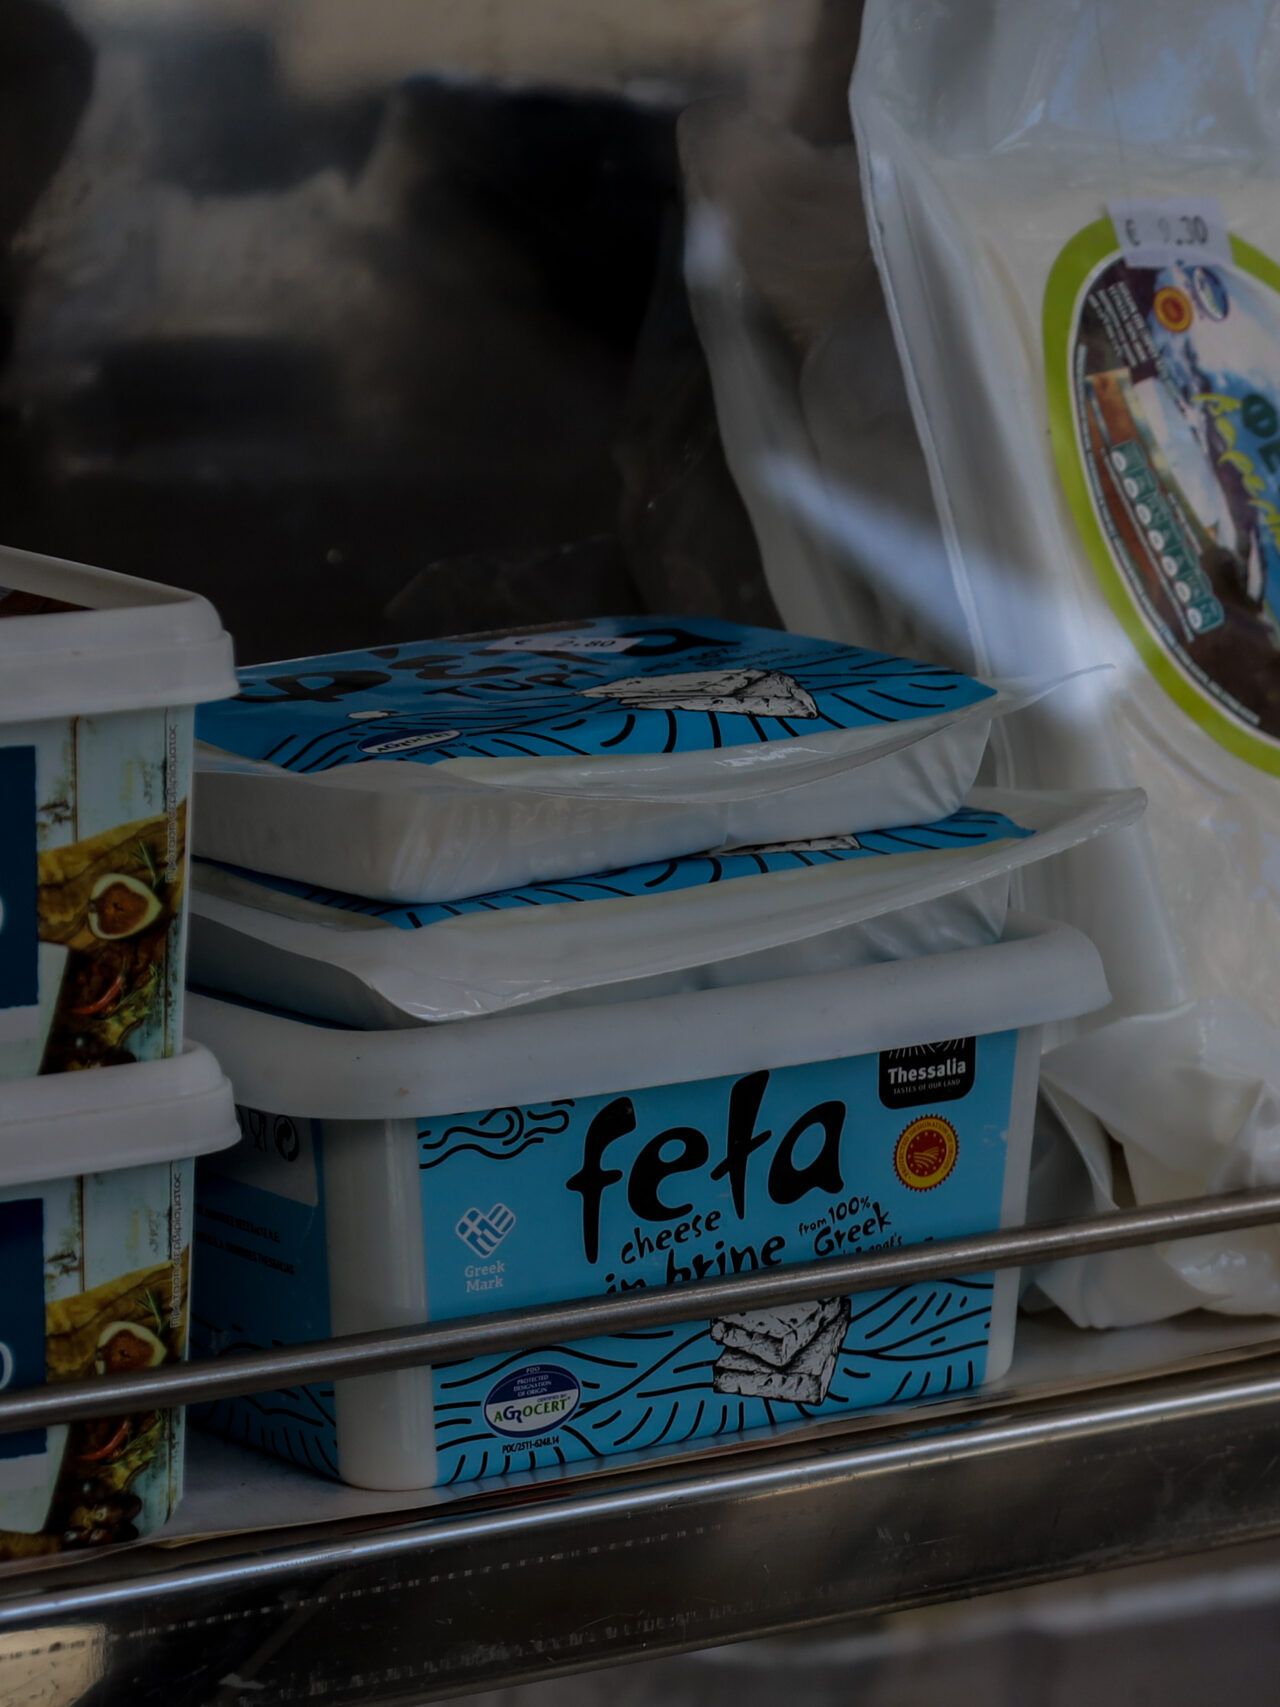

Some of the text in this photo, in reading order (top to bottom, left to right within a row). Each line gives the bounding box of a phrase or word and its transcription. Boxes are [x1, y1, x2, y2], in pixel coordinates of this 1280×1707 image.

[887, 1057, 967, 1085] Thessalia
[566, 1070, 846, 1264] feta
[799, 1196, 871, 1236] from 100%
[814, 1202, 892, 1256] Greek
[621, 1211, 721, 1264] cheese
[464, 1260, 505, 1278] Greek
[465, 1275, 504, 1293] Mark
[493, 1399, 568, 1424] AGROCERT
